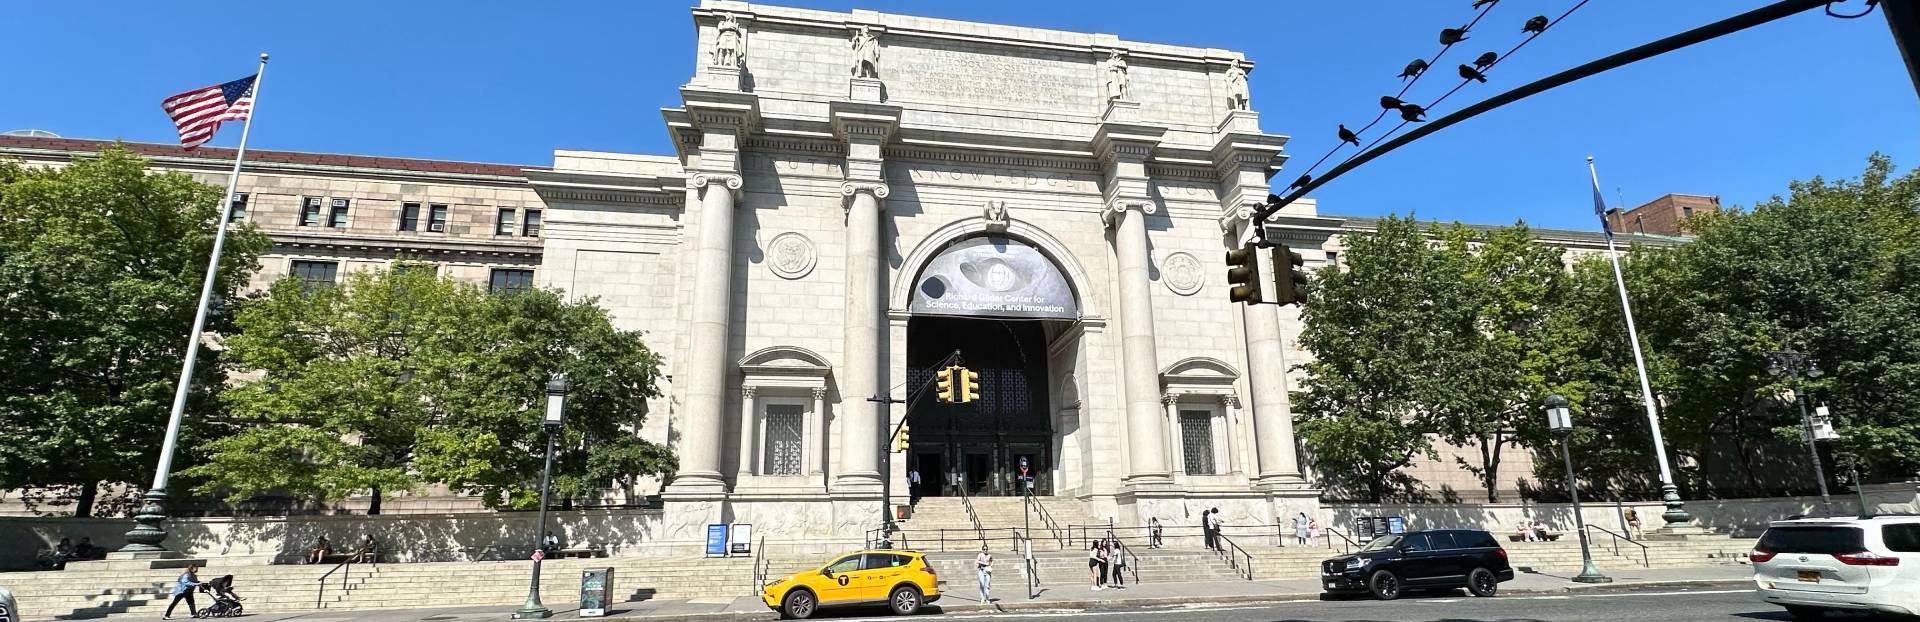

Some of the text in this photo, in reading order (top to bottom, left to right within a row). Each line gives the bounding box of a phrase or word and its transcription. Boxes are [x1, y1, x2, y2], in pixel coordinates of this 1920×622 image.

[913, 166, 1073, 188] KNOWLEDGE
[945, 292, 978, 301] Richard
[1005, 294, 1032, 303] Center
[1034, 295, 1045, 303] for
[925, 300, 1064, 313] Science, Education, and Innovation
